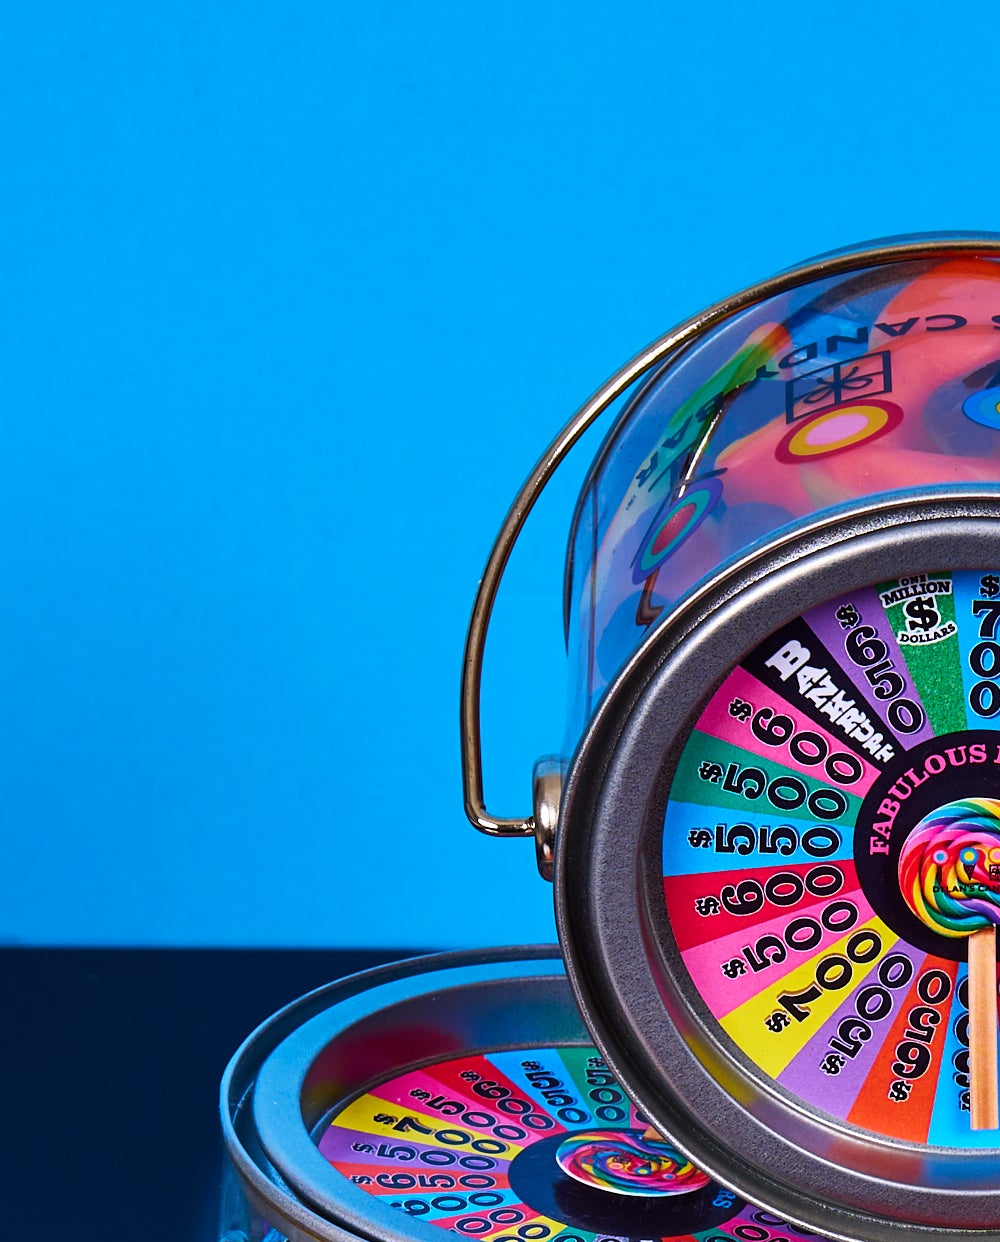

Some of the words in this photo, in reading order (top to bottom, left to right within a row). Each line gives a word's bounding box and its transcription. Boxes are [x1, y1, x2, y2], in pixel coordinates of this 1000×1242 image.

[744, 314, 968, 392] CANDY
[881, 580, 952, 606] MILLION
[901, 574, 927, 587] ONE
[900, 623, 956, 643] DOLLARS
[764, 640, 896, 763] BANKRUPT
[869, 744, 987, 857] FABULOUS
